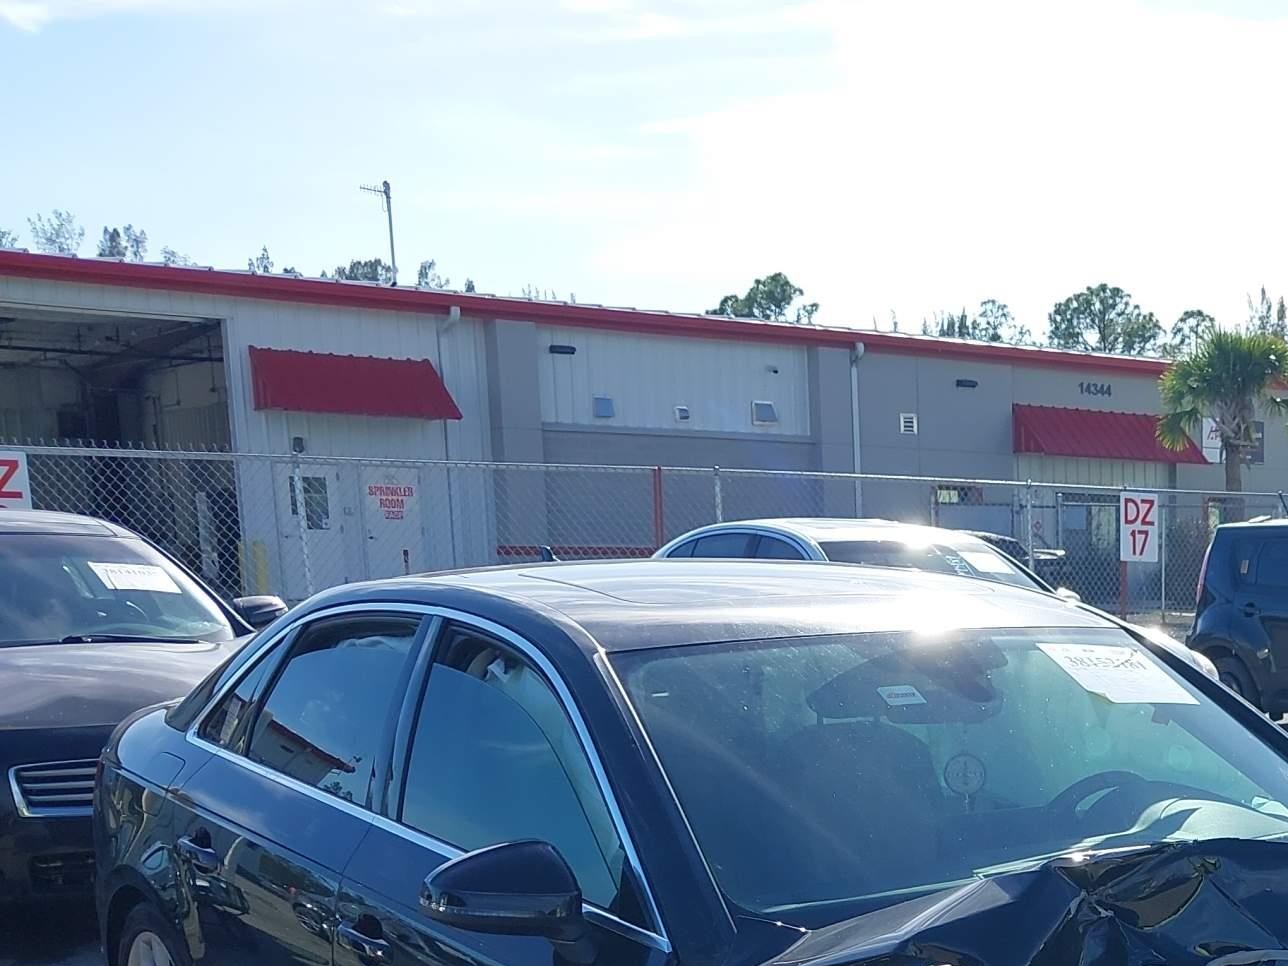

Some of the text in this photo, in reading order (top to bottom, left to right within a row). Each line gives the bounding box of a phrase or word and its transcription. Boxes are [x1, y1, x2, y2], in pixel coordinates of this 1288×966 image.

[1078, 382, 1112, 397] 14344
[368, 485, 414, 497] SPRINKLER
[379, 498, 405, 509] ROOM
[1124, 497, 1155, 526] DZ
[1130, 529, 1149, 556] 17
